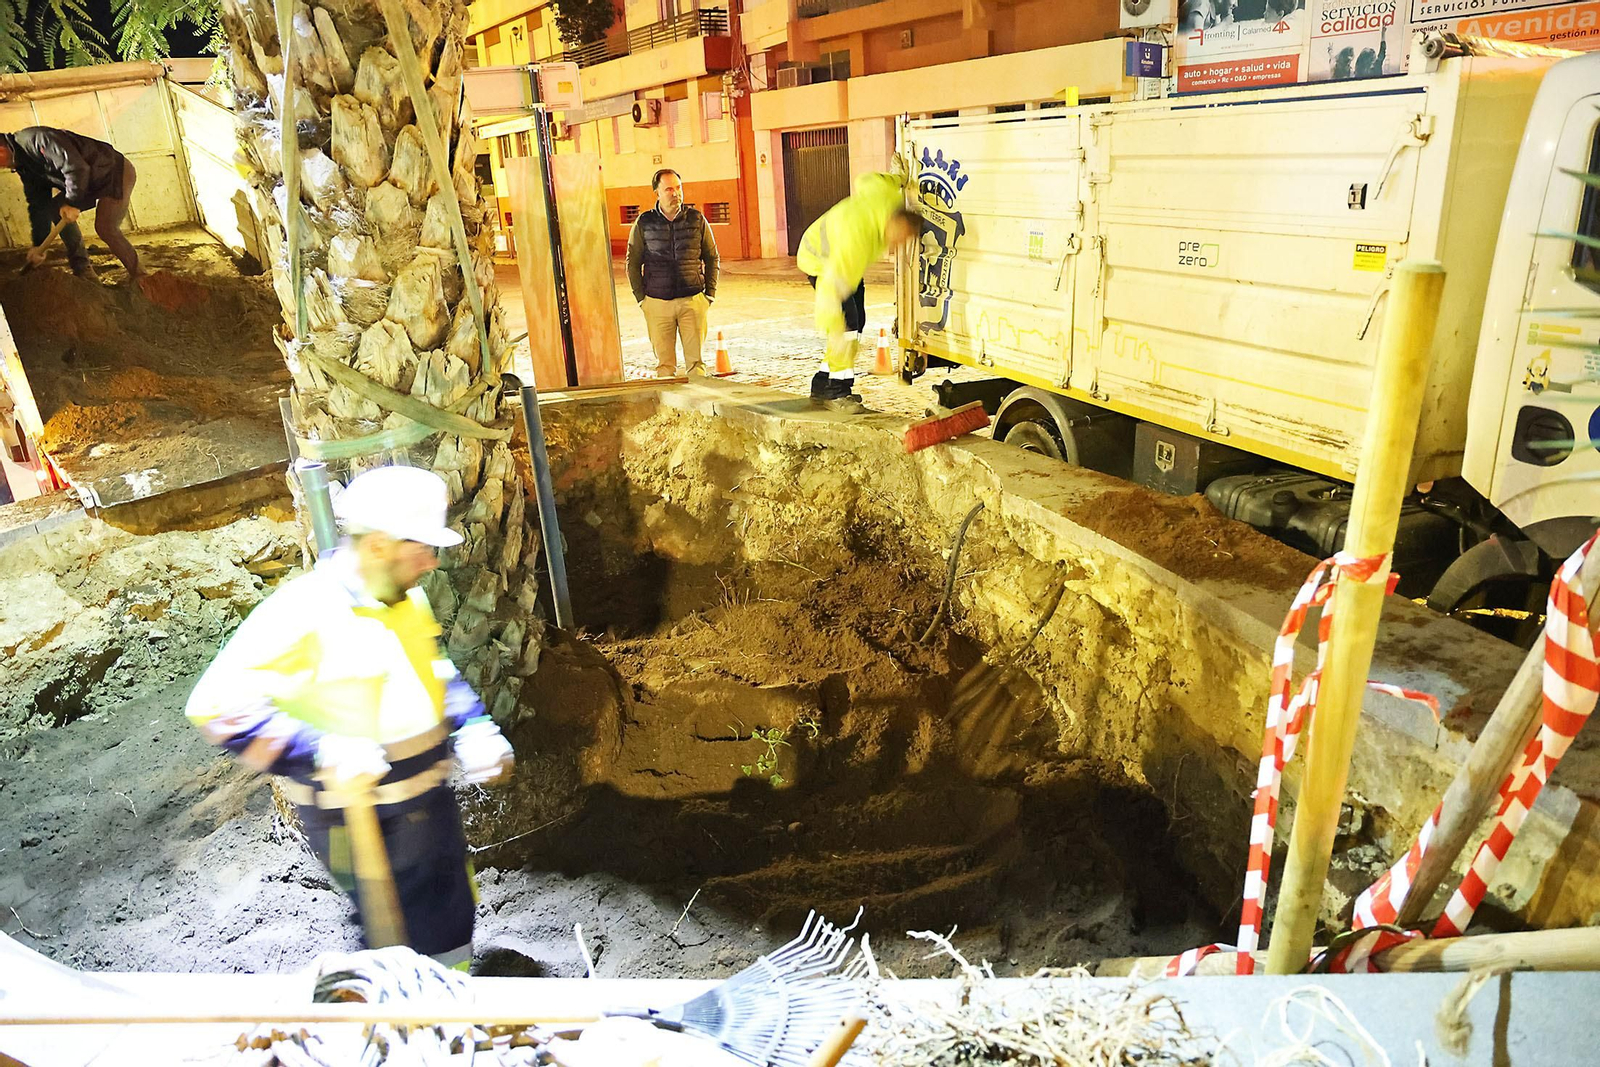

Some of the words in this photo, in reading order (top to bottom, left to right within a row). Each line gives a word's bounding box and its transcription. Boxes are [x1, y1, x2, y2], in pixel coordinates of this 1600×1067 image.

[1321, 0, 1396, 21] servicios
[1420, 0, 1486, 15] SERVICIOS
[1320, 11, 1394, 33] calidad
[1464, 8, 1597, 38] Avenida
[1204, 30, 1236, 40] fronting
[1550, 29, 1587, 41] gestión
[1184, 70, 1201, 78] auto
[1209, 67, 1233, 77] hogar
[1241, 63, 1264, 73] salud
[1273, 61, 1291, 70] vida
[1191, 78, 1217, 86] comercio
[1252, 72, 1282, 81] empresas
[1179, 241, 1200, 253] pre
[1357, 245, 1385, 253] PELIGRO
[1178, 255, 1207, 267] zero
